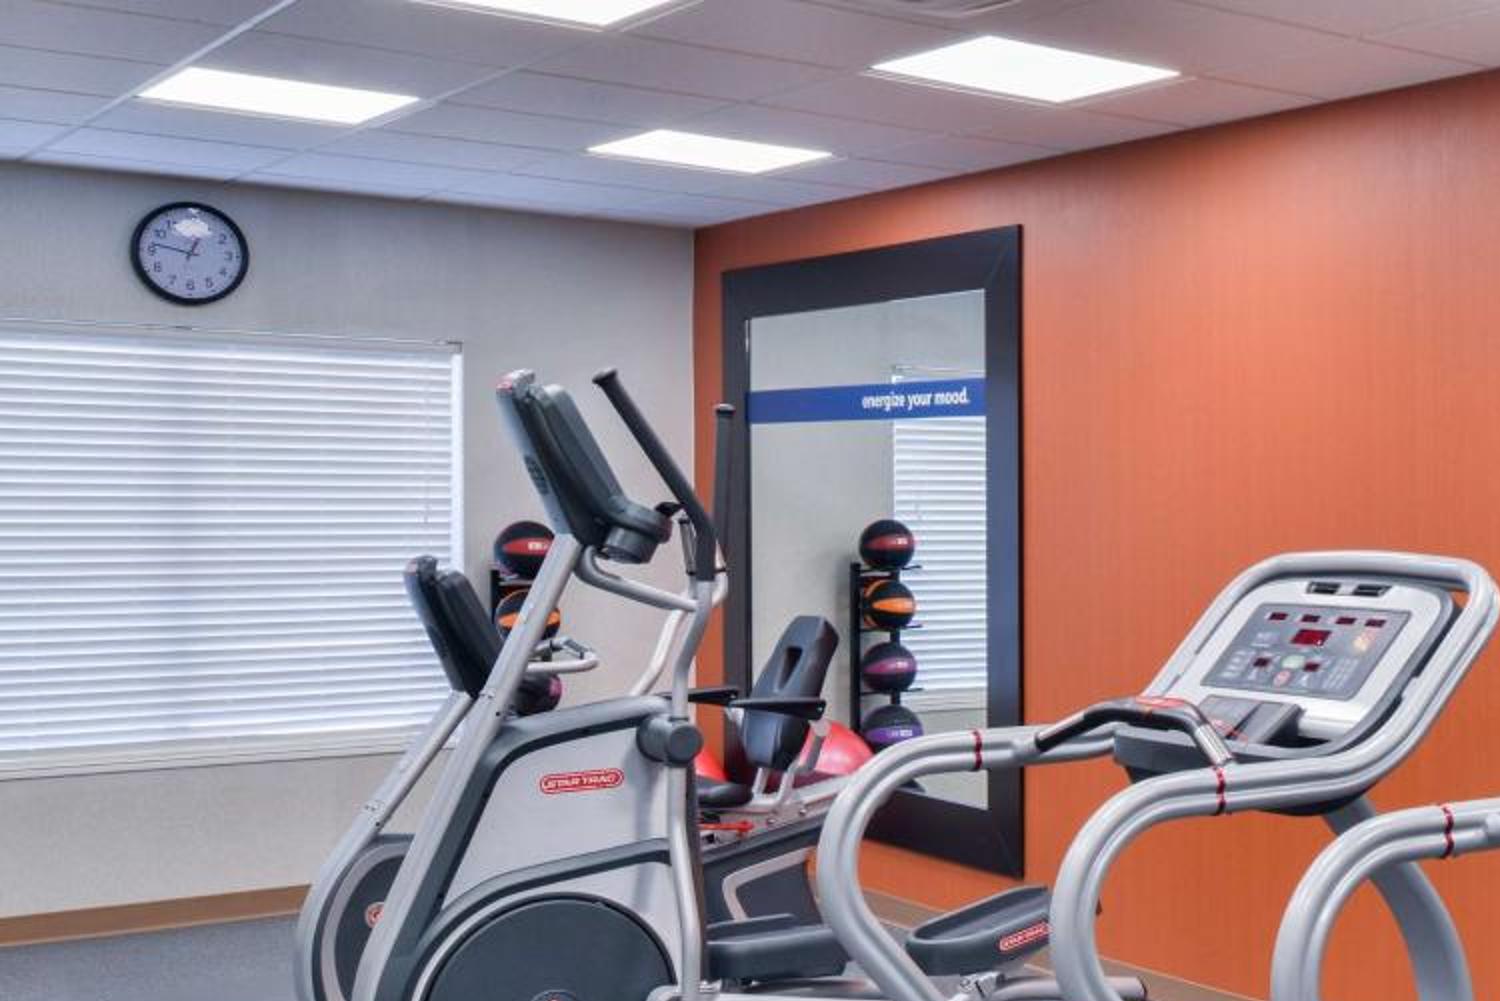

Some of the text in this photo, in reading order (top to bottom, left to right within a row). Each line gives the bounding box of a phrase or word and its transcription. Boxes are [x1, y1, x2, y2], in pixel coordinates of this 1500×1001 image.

[862, 386, 970, 412] energize your mood.
